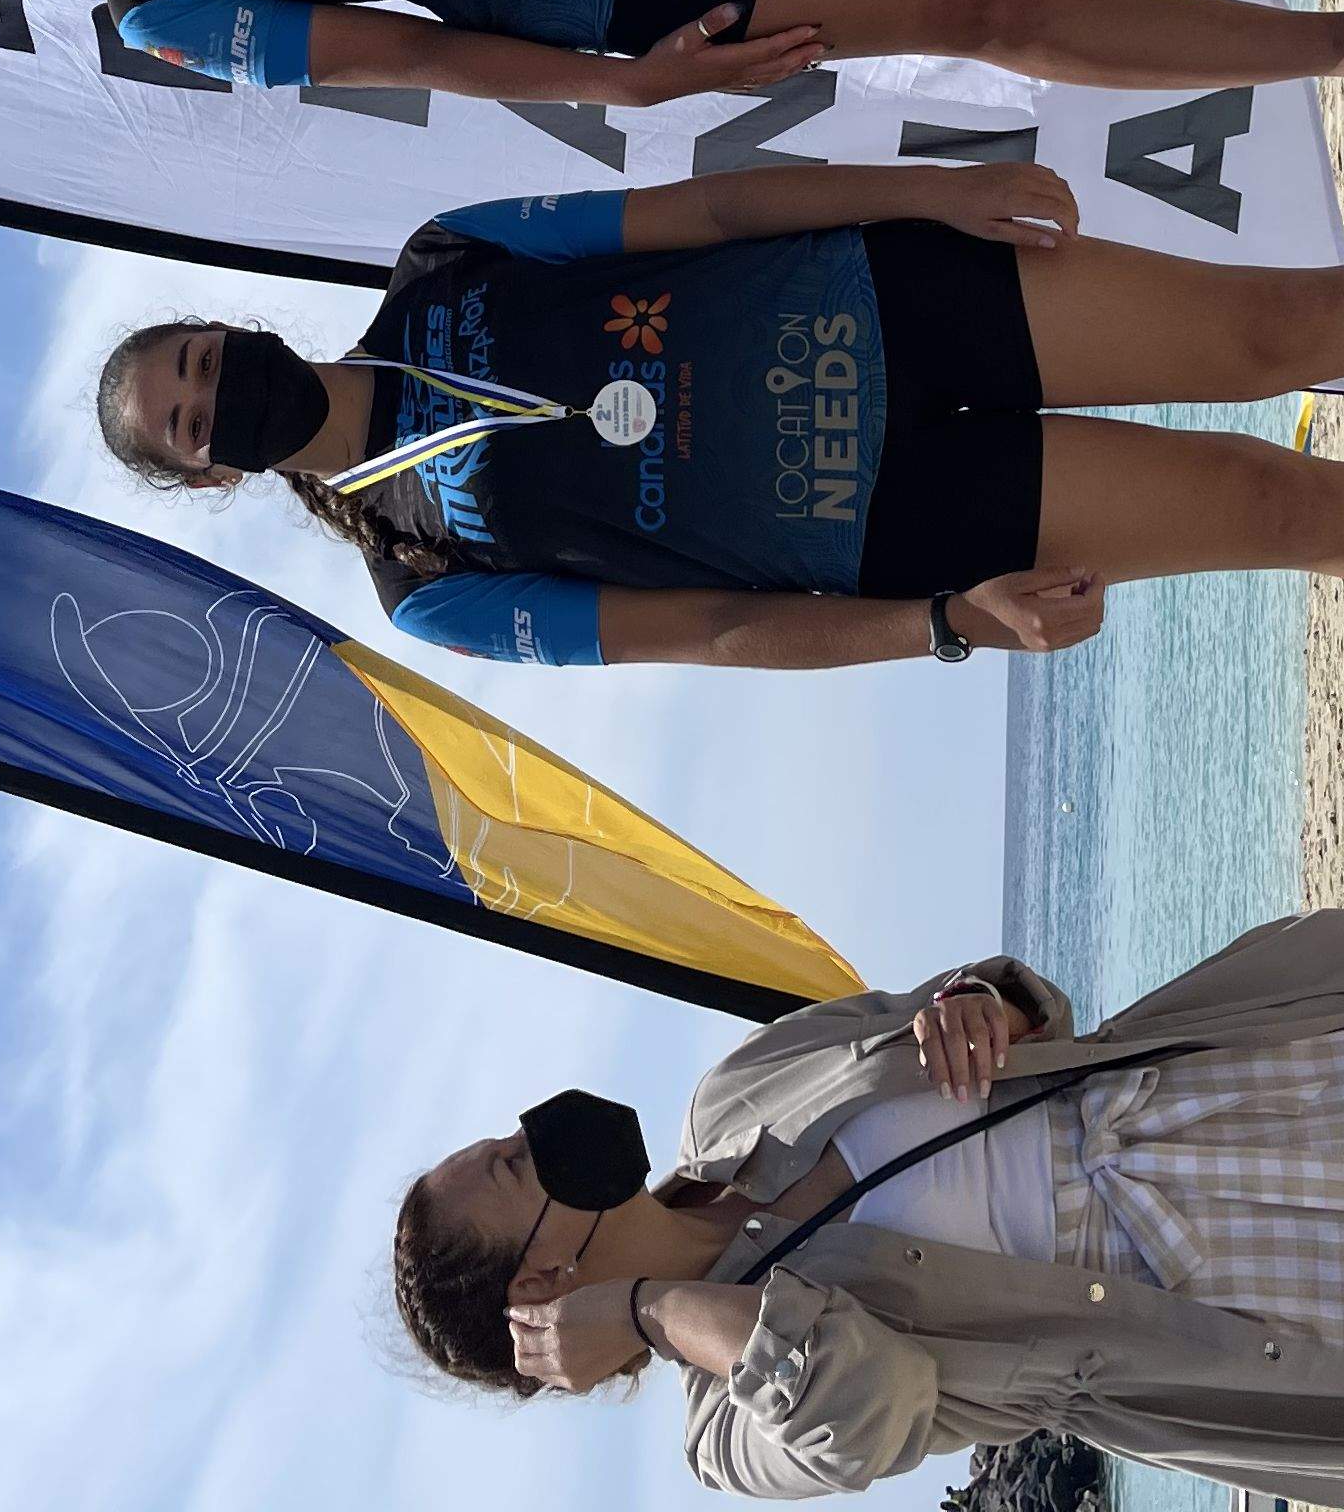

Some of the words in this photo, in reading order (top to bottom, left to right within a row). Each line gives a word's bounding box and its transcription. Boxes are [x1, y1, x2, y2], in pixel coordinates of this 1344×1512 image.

[677, 360, 694, 388] VIDA
[677, 392, 692, 406] DE
[812, 312, 858, 521] NEEDS
[676, 411, 693, 459] LATITUD
